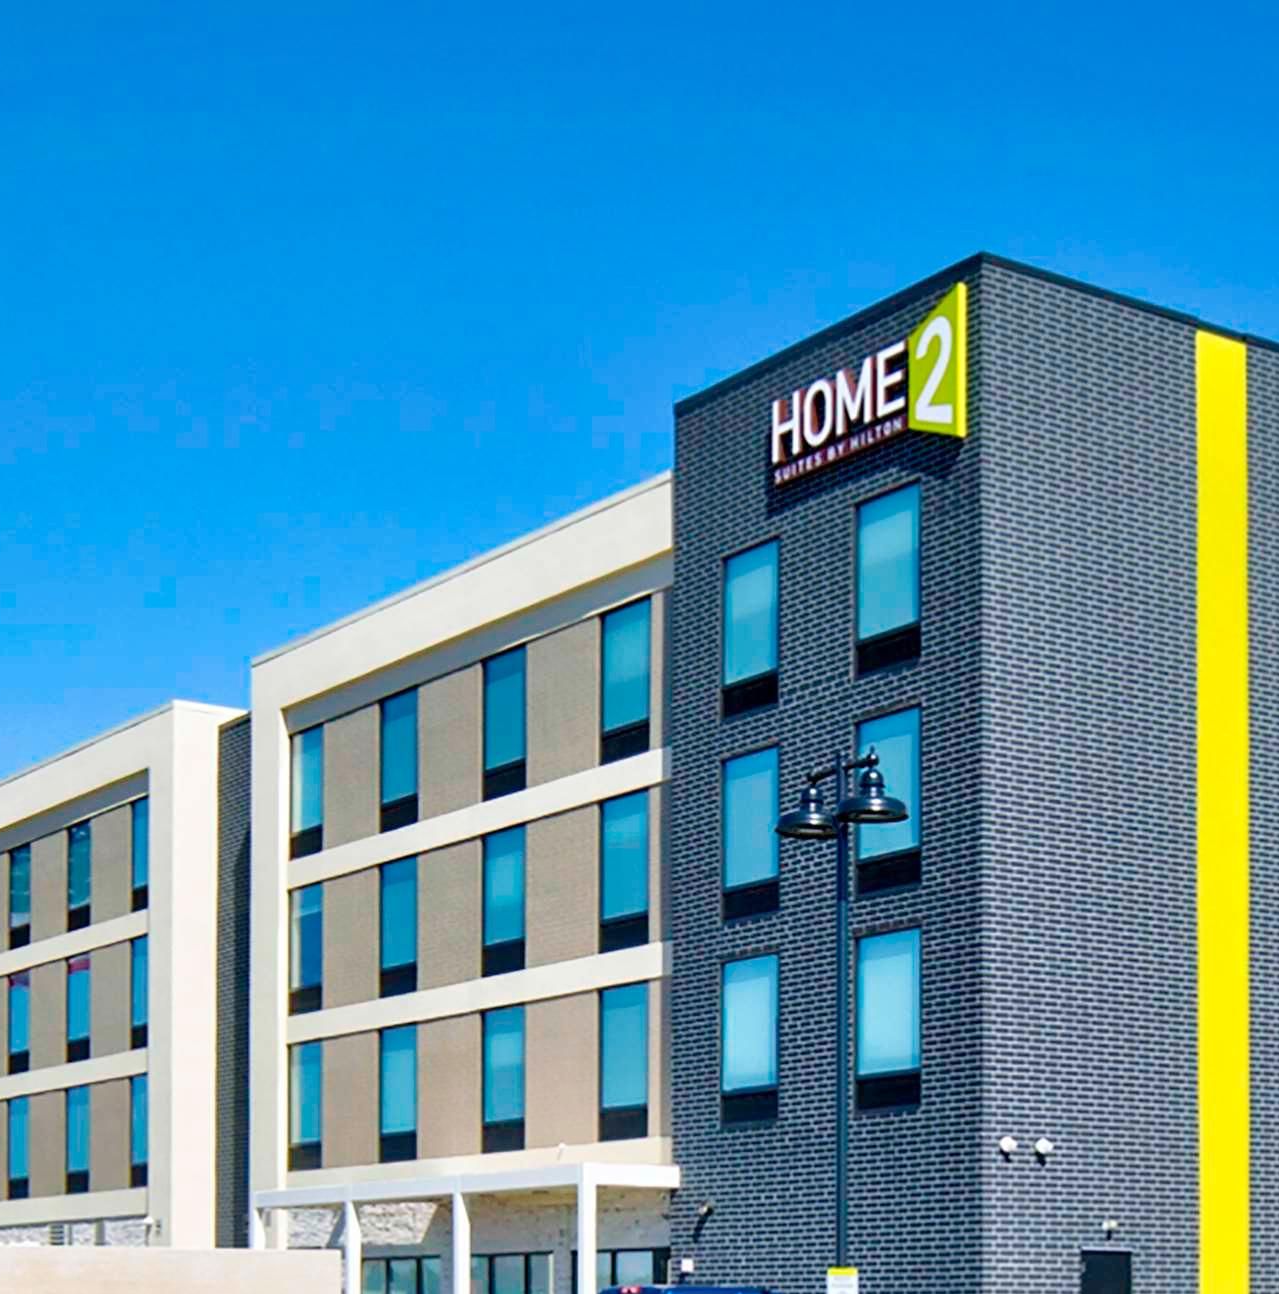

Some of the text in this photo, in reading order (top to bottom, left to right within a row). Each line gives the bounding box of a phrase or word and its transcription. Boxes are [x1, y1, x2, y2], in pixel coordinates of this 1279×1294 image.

[774, 417, 903, 485] SUITES BY HILTON
